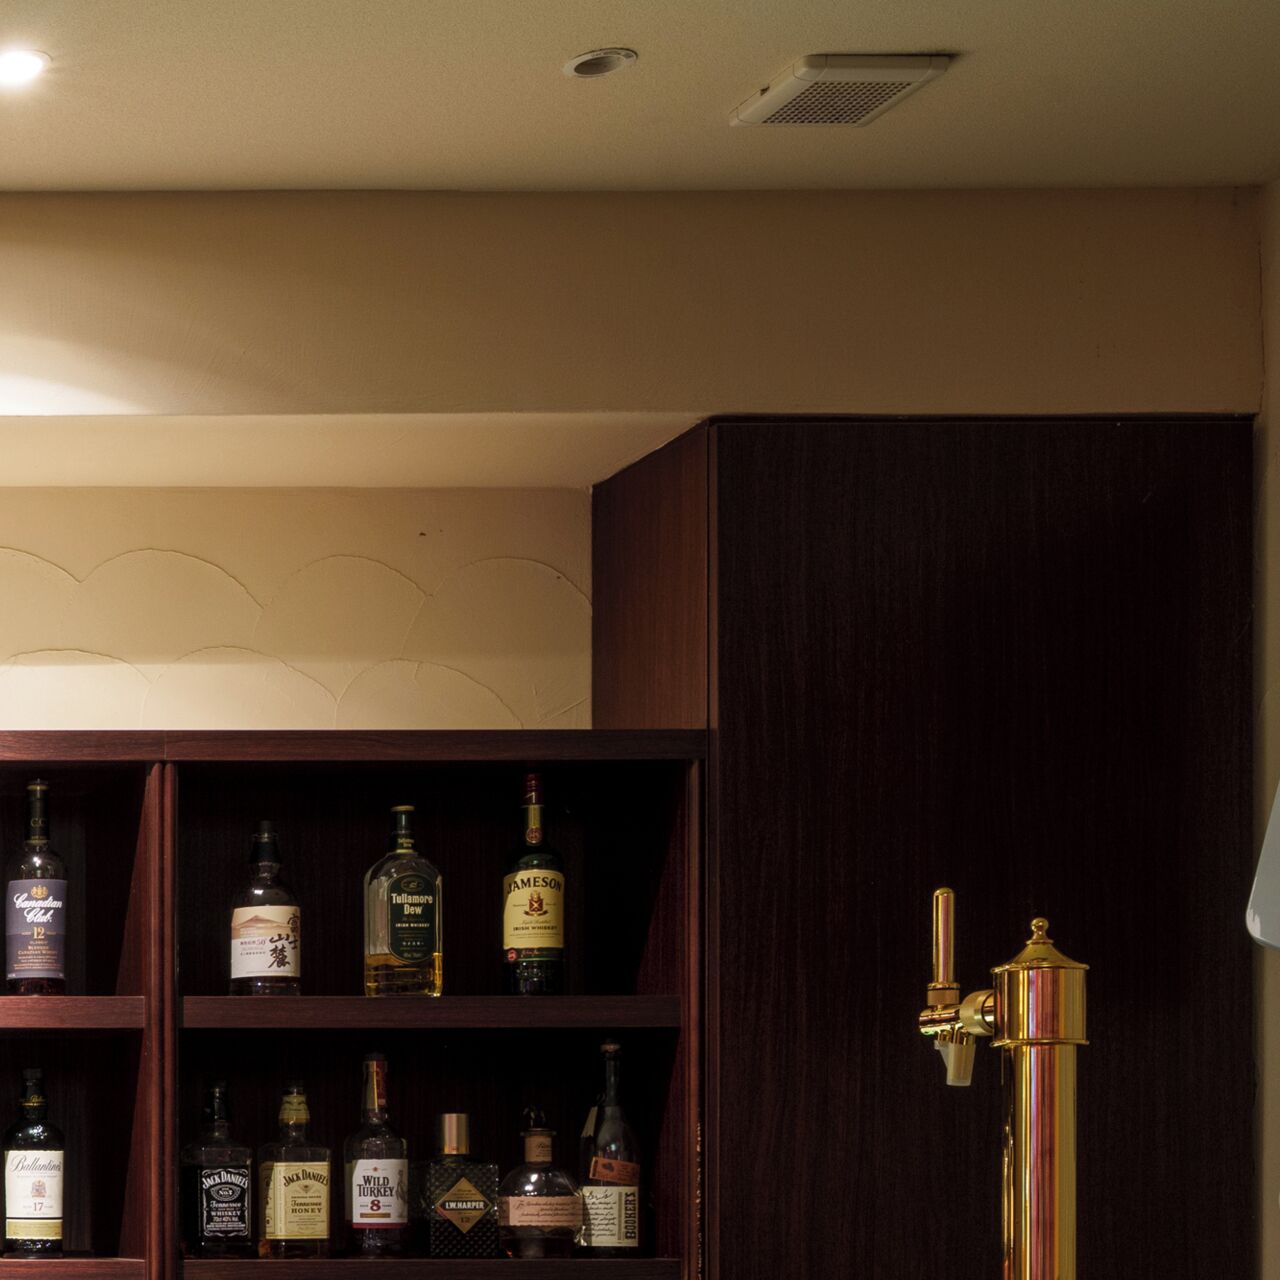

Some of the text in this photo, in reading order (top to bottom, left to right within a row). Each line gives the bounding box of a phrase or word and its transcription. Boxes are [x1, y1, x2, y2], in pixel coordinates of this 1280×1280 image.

[507, 876, 562, 894] JAMESON
[13, 893, 62, 908] Canadian
[391, 893, 434, 904] Tullamore
[24, 908, 54, 923] Club
[403, 904, 423, 915] Dew
[33, 926, 45, 938] 12
[202, 1174, 222, 1190] JACK
[283, 1168, 329, 1188] JACK DANIEL'S
[362, 1175, 391, 1187] WILD
[356, 1184, 396, 1198] TURKEY
[33, 1202, 44, 1212] 17
[370, 1200, 382, 1212] 8
